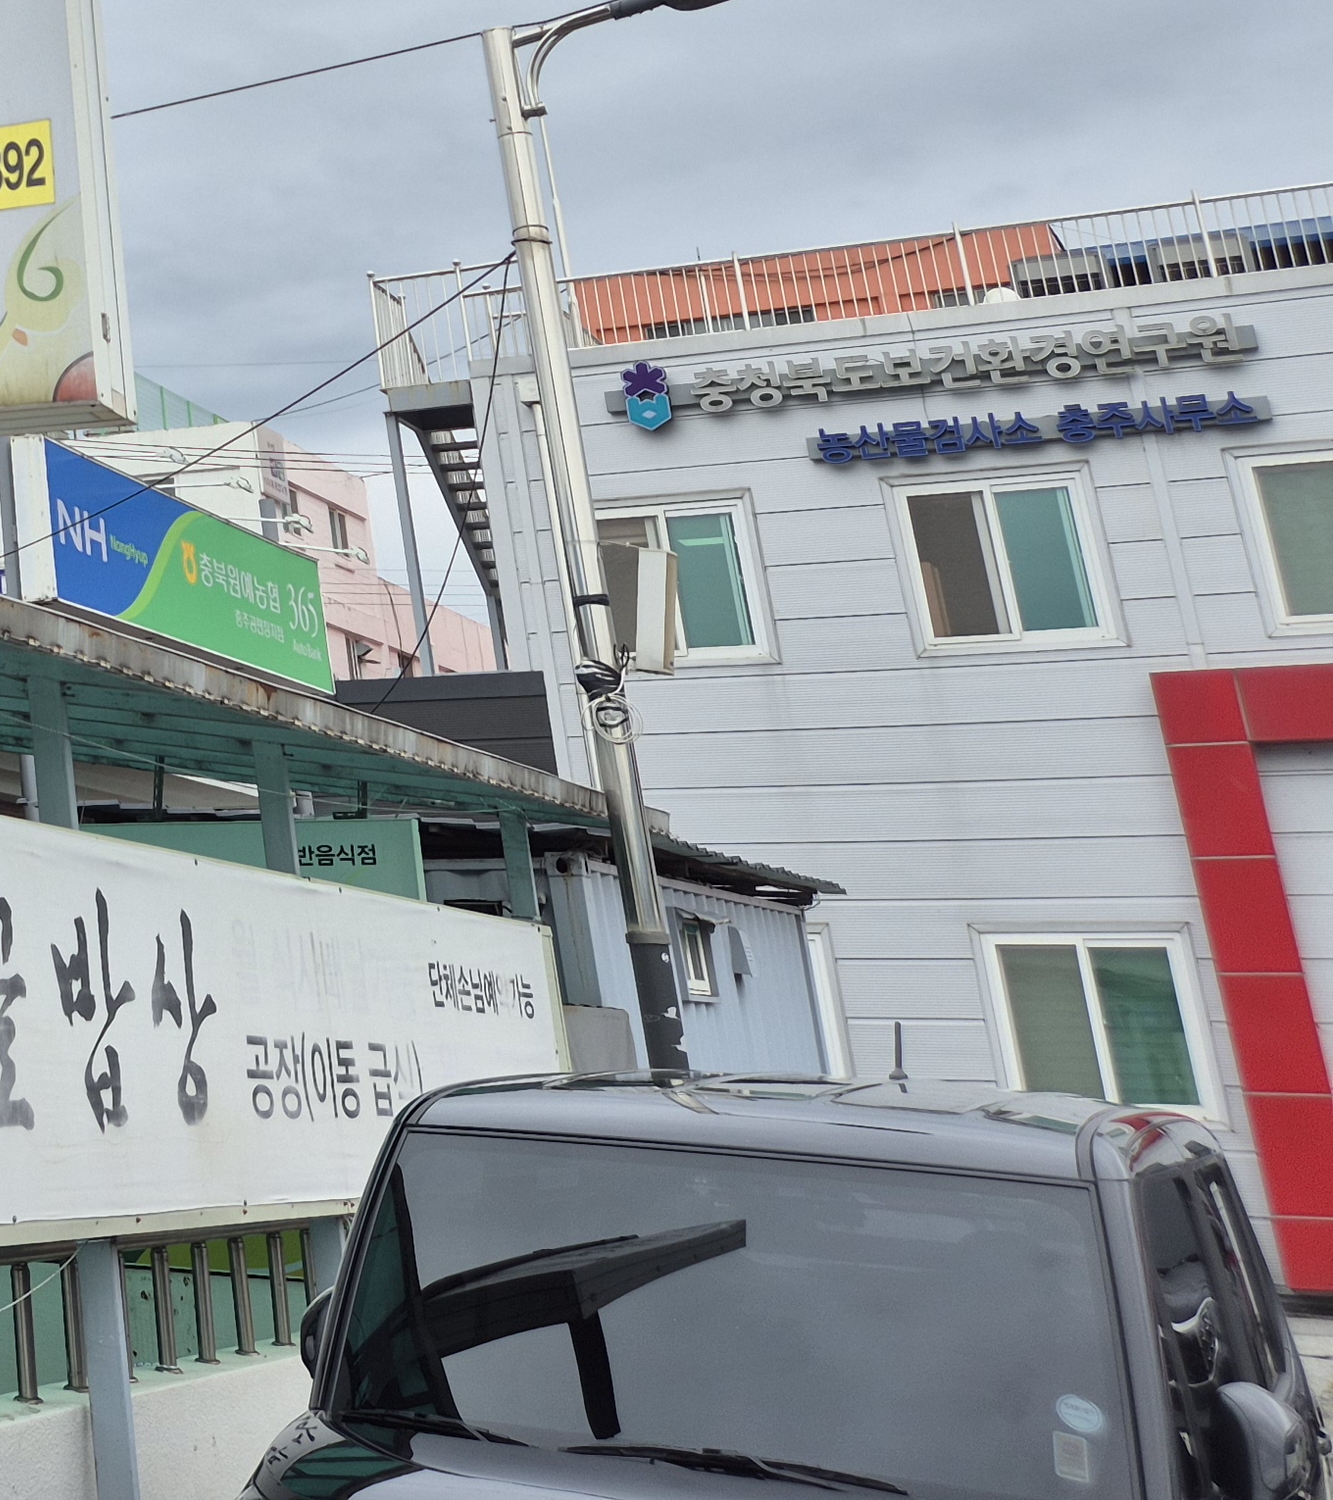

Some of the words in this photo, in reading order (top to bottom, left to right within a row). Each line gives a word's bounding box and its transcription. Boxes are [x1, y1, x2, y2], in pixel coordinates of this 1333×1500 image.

[690, 313, 1244, 413] 충청북도보건환경연구원
[817, 411, 1043, 465] 농산물검사소
[1056, 390, 1260, 443] 충주사무소
[56, 498, 108, 563] NH
[199, 552, 281, 614] 충북원예농협
[286, 583, 318, 638] 365
[298, 844, 377, 866] 반음식점
